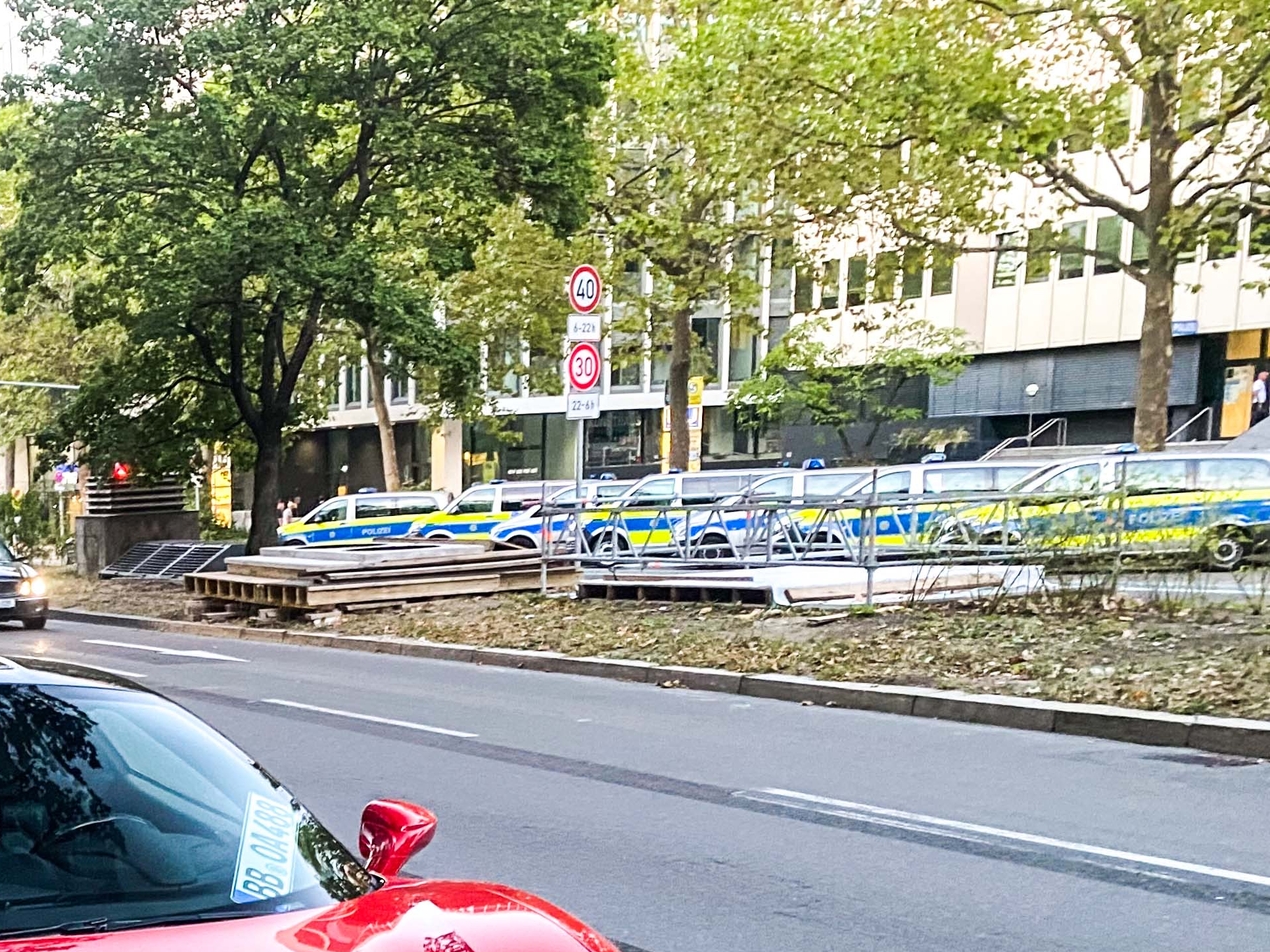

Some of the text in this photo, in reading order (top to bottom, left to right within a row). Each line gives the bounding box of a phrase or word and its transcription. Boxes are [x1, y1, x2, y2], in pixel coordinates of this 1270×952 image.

[576, 278, 595, 299] 40
[573, 323, 596, 333] 6-22h
[575, 357, 593, 377] 30
[571, 400, 595, 411] 22-6h
[361, 526, 392, 536] POLIZEI
[242, 867, 285, 899] BB
